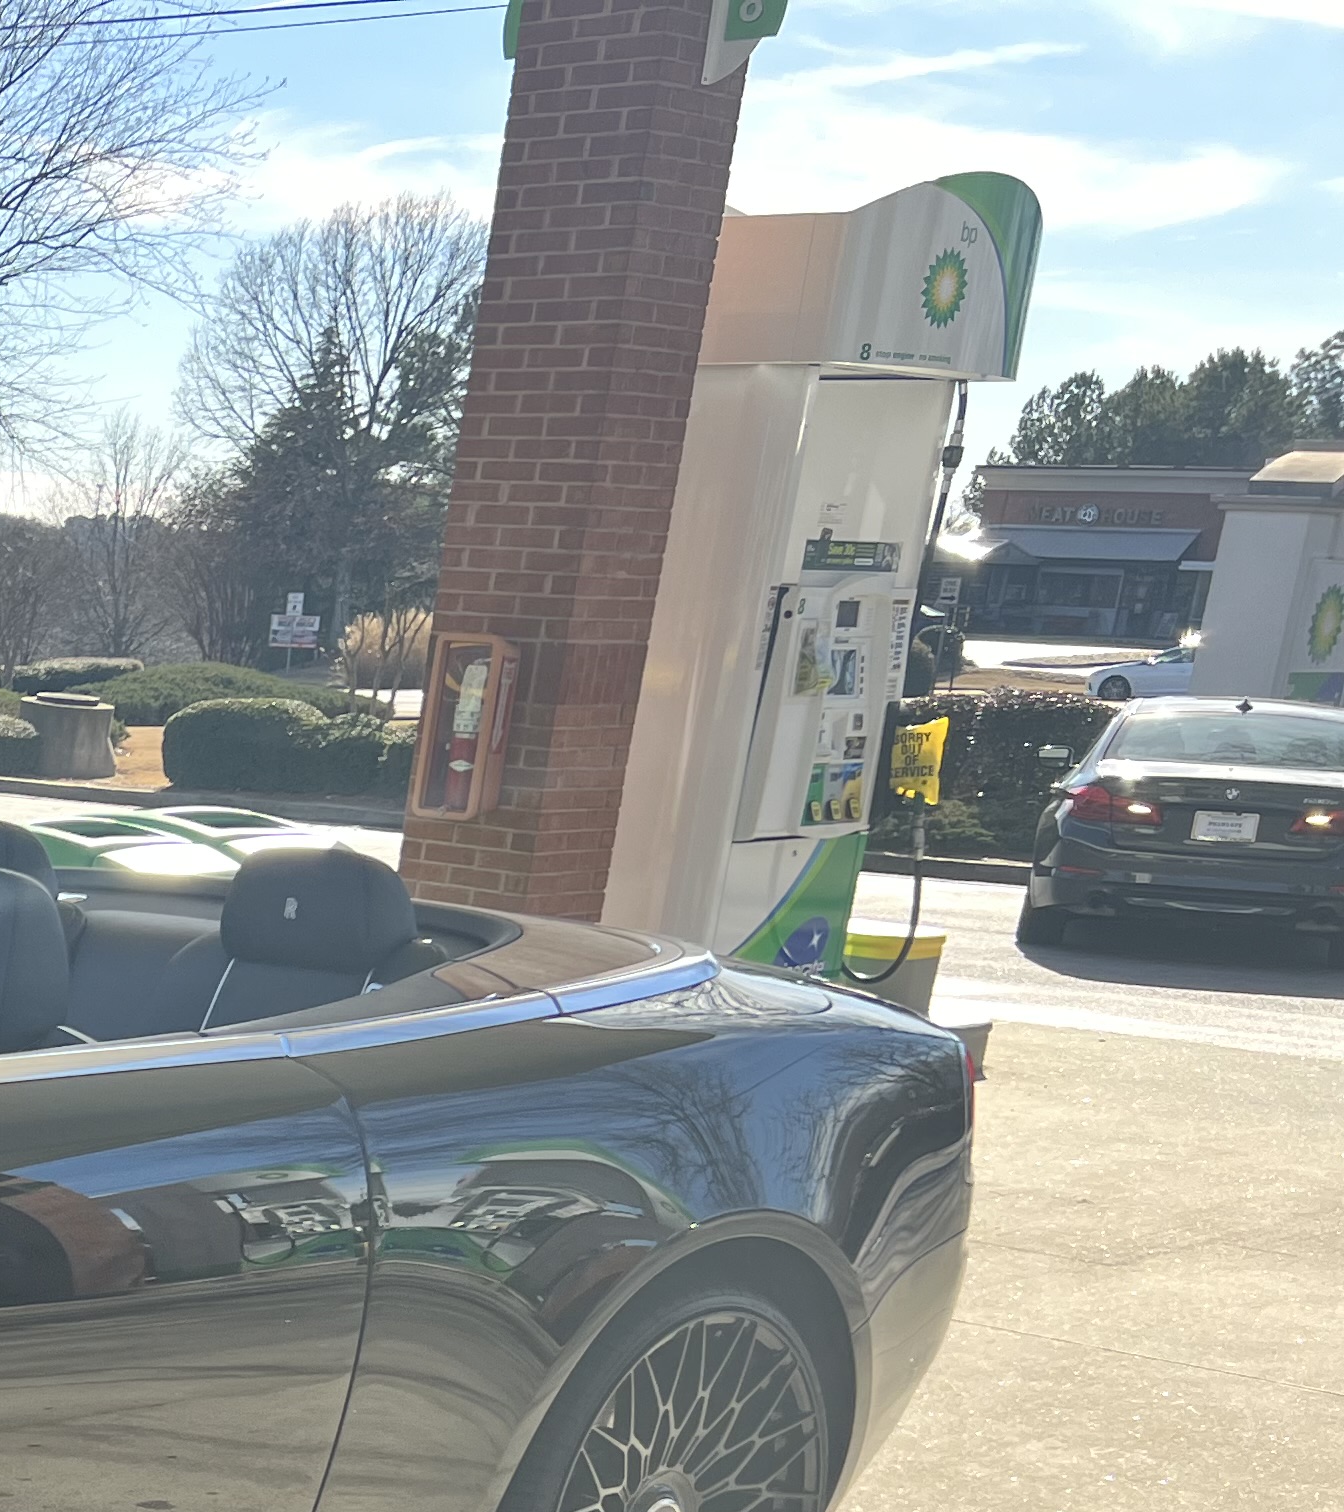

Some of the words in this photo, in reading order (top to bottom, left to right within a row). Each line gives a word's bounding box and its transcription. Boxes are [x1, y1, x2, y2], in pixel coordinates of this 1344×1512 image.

[960, 221, 977, 248] bp
[859, 343, 871, 360] 8
[798, 598, 806, 614] 8
[901, 743, 922, 755] OUT
[904, 754, 919, 766] OF
